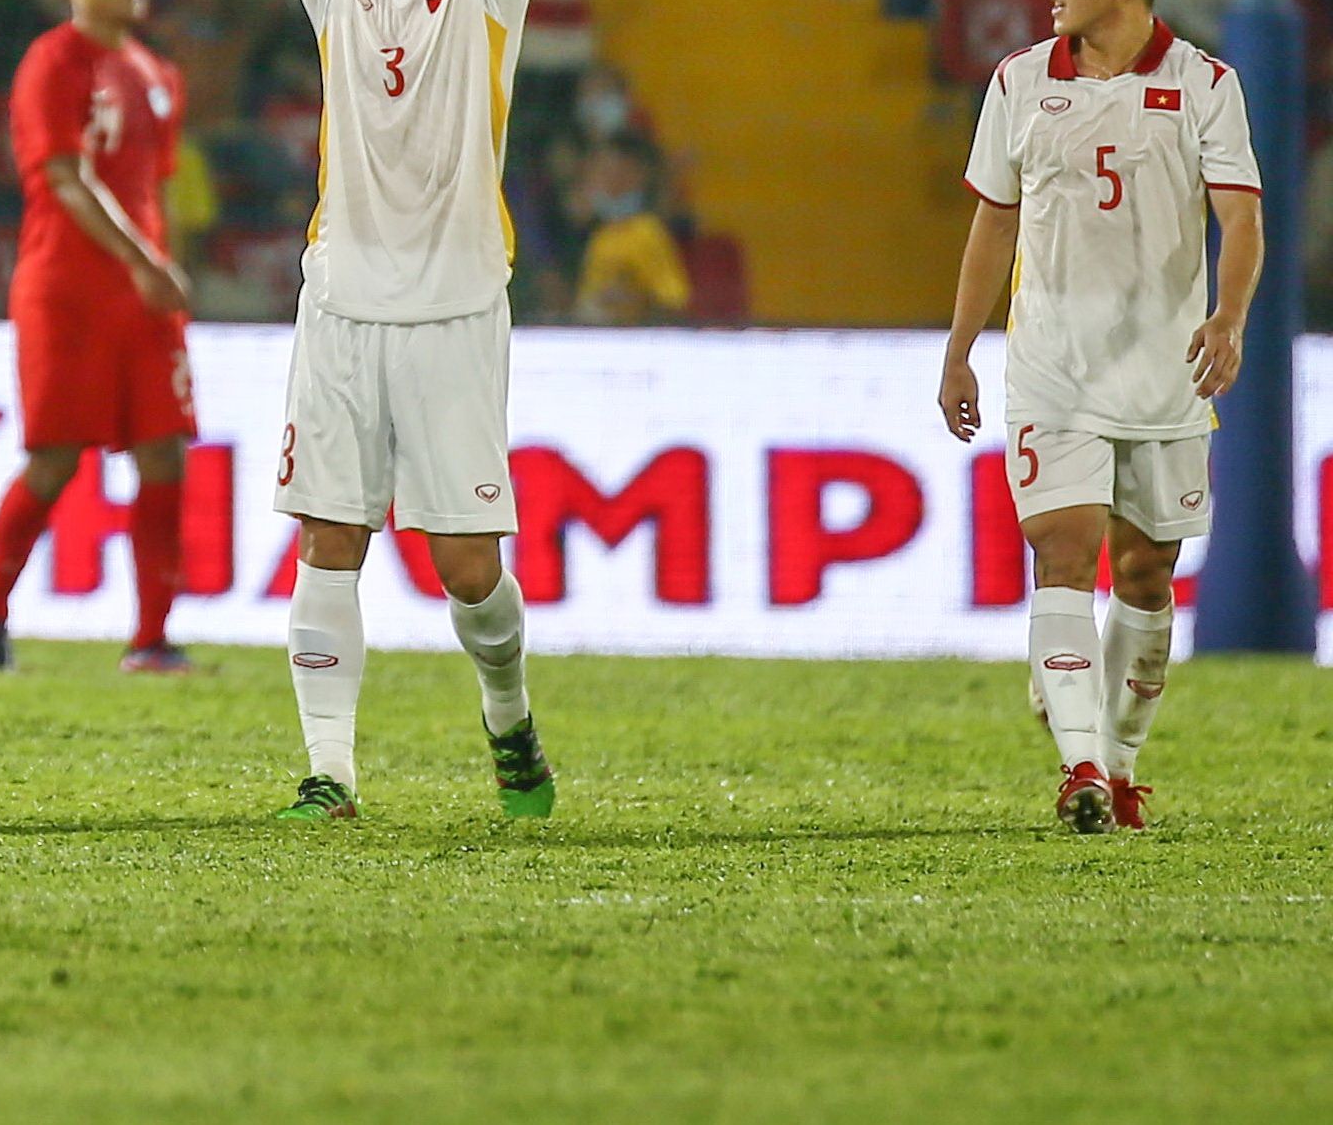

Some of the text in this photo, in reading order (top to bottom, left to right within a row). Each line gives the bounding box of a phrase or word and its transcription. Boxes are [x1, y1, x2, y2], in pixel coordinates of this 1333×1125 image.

[381, 46, 406, 98] 3
[1096, 145, 1124, 211] 5
[277, 423, 296, 487] 3
[1018, 423, 1039, 488] 5
